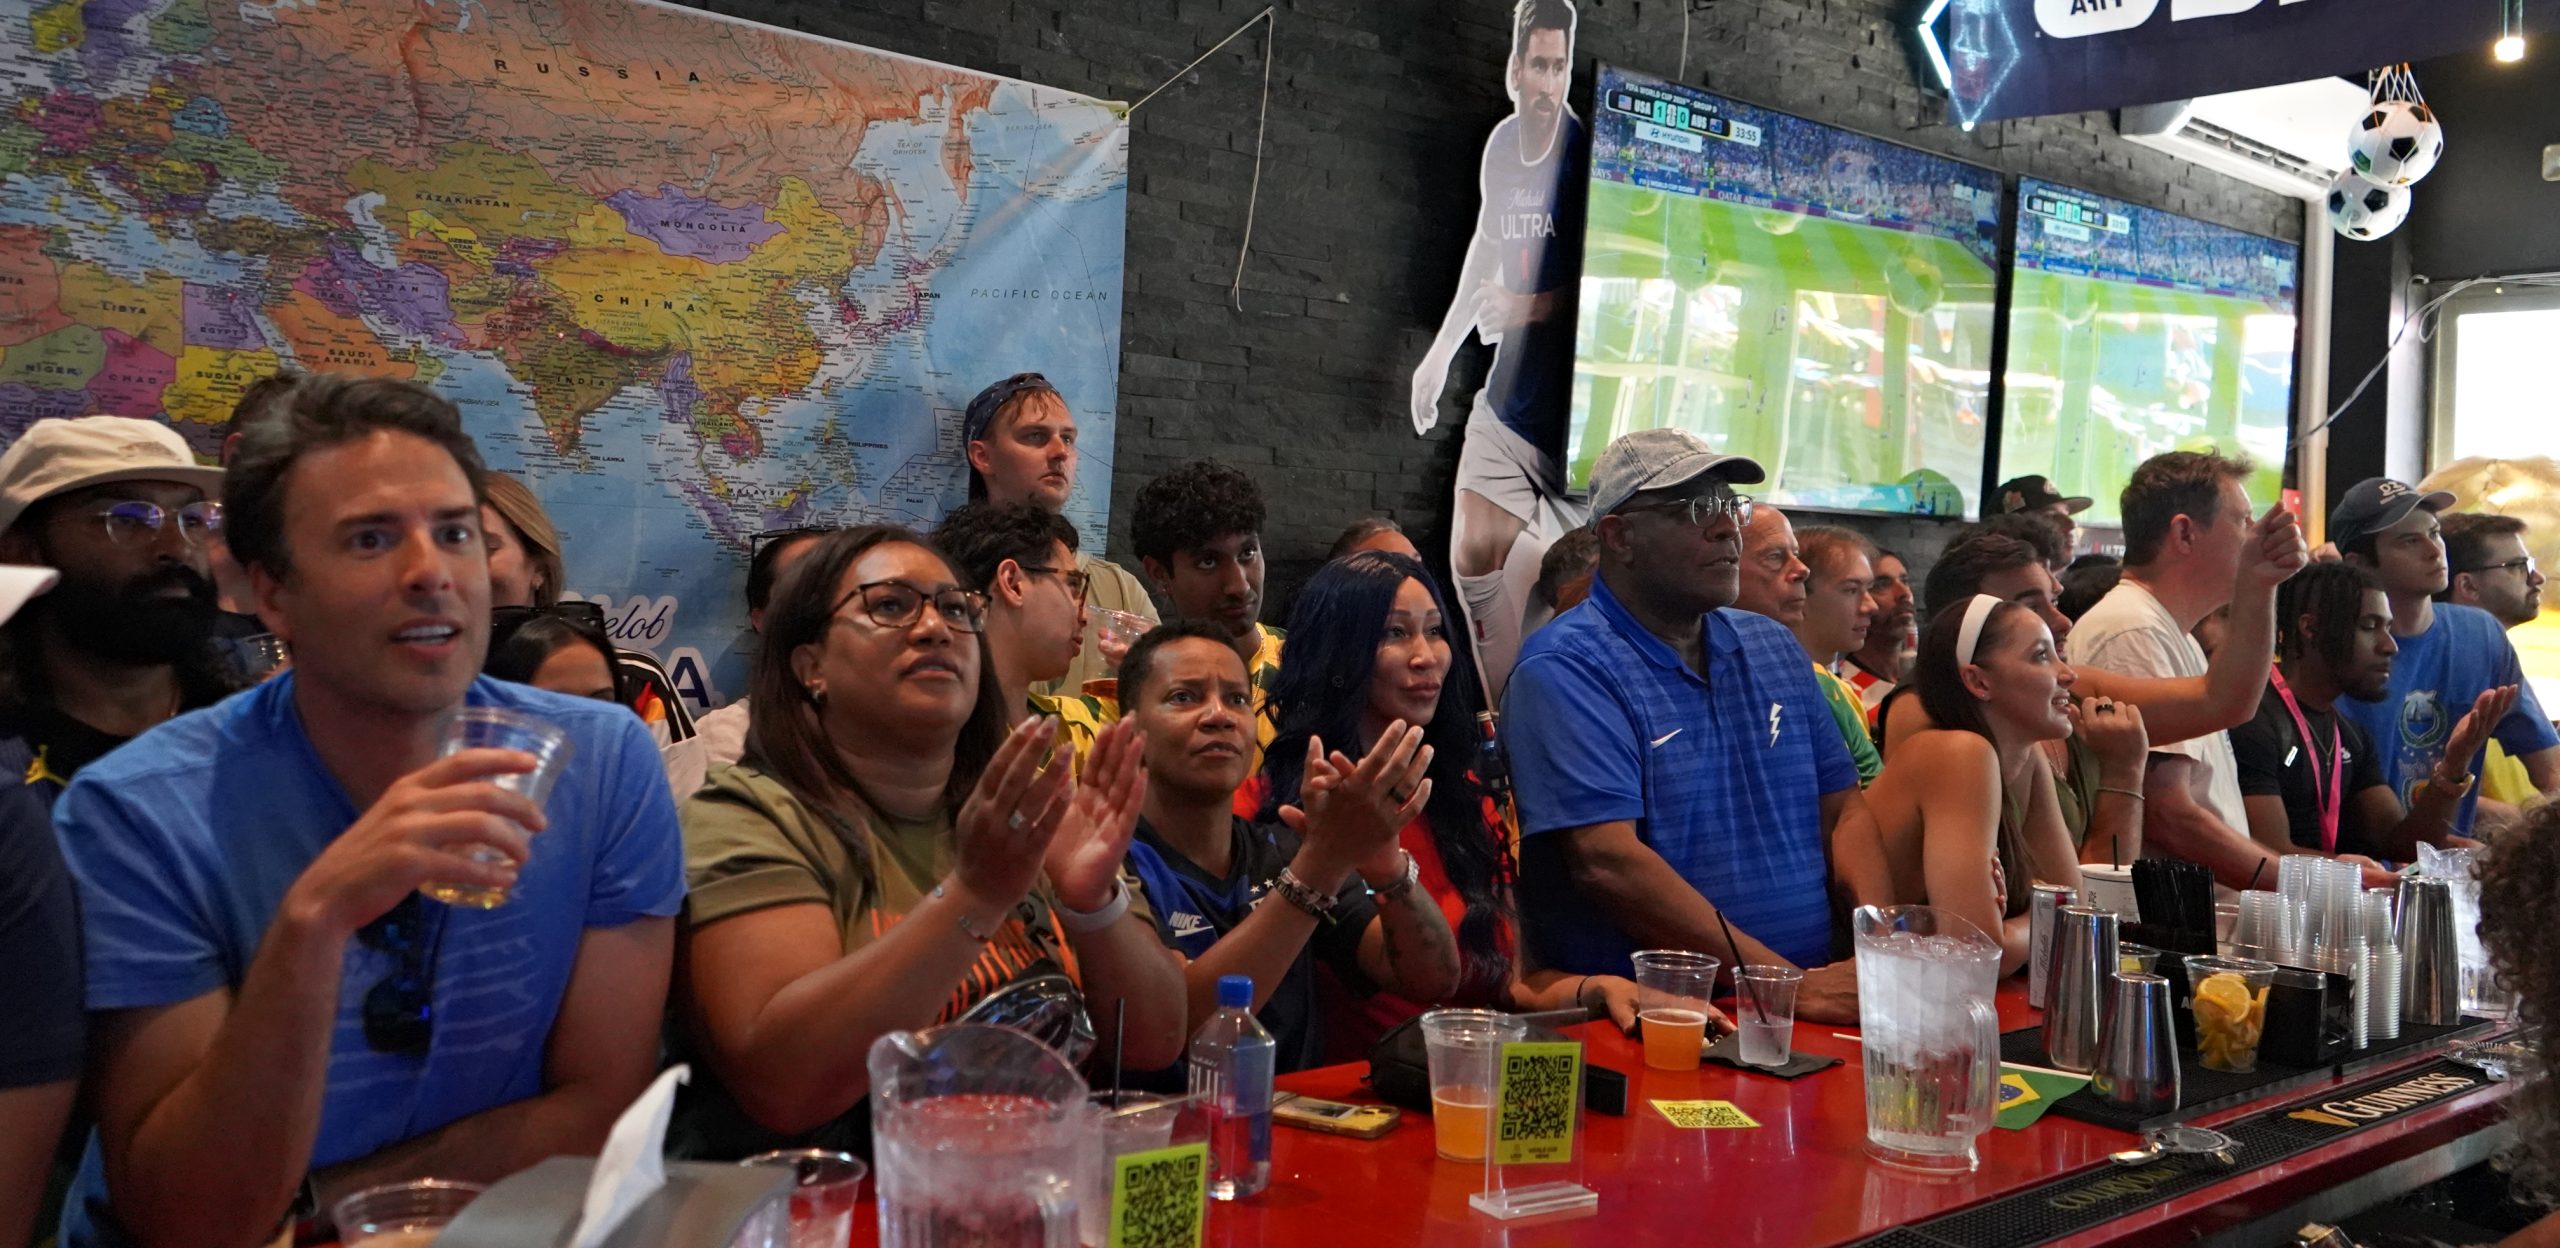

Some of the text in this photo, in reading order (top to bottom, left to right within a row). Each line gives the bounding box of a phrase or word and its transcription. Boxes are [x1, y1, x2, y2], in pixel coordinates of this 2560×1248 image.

[494, 59, 700, 83] RUSSIA
[1640, 86, 1660, 98] WORLD
[1661, 89, 1672, 100] CUP
[1693, 101, 1712, 112] GROUP
[115, 106, 158, 118] POLAND
[1634, 99, 1757, 142] USA 1 0 AUS 33:55
[415, 193, 511, 208] KAZAKHSTAN
[1718, 190, 1741, 203] QATAR
[660, 219, 746, 233] MONGOLIA
[1501, 212, 1556, 240] ULTRA
[378, 282, 419, 293] IRAN
[913, 291, 941, 299] JAPAN
[971, 288, 1108, 300] PACIFIC OCEAN
[102, 302, 147, 314] LIBYA
[593, 294, 695, 312] CHINA
[200, 326, 238, 336] EGYPT
[486, 323, 532, 333] PAKISTAN
[328, 348, 372, 359] SAUDI
[324, 356, 376, 367] ARABIA
[25, 363, 80, 376] NIGER
[195, 370, 242, 381] SUDAN
[108, 373, 157, 385] CHAD
[557, 376, 605, 386] INDIA
[697, 420, 734, 428] THAILAND
[847, 441, 889, 449] PHILIPPINES
[727, 487, 789, 497] MALAYSIA
[2101, 544, 2126, 558] ULTR
[603, 604, 669, 640] elob
[1168, 911, 1202, 930] NIKE
[2322, 1072, 2475, 1118] GUINNESS
